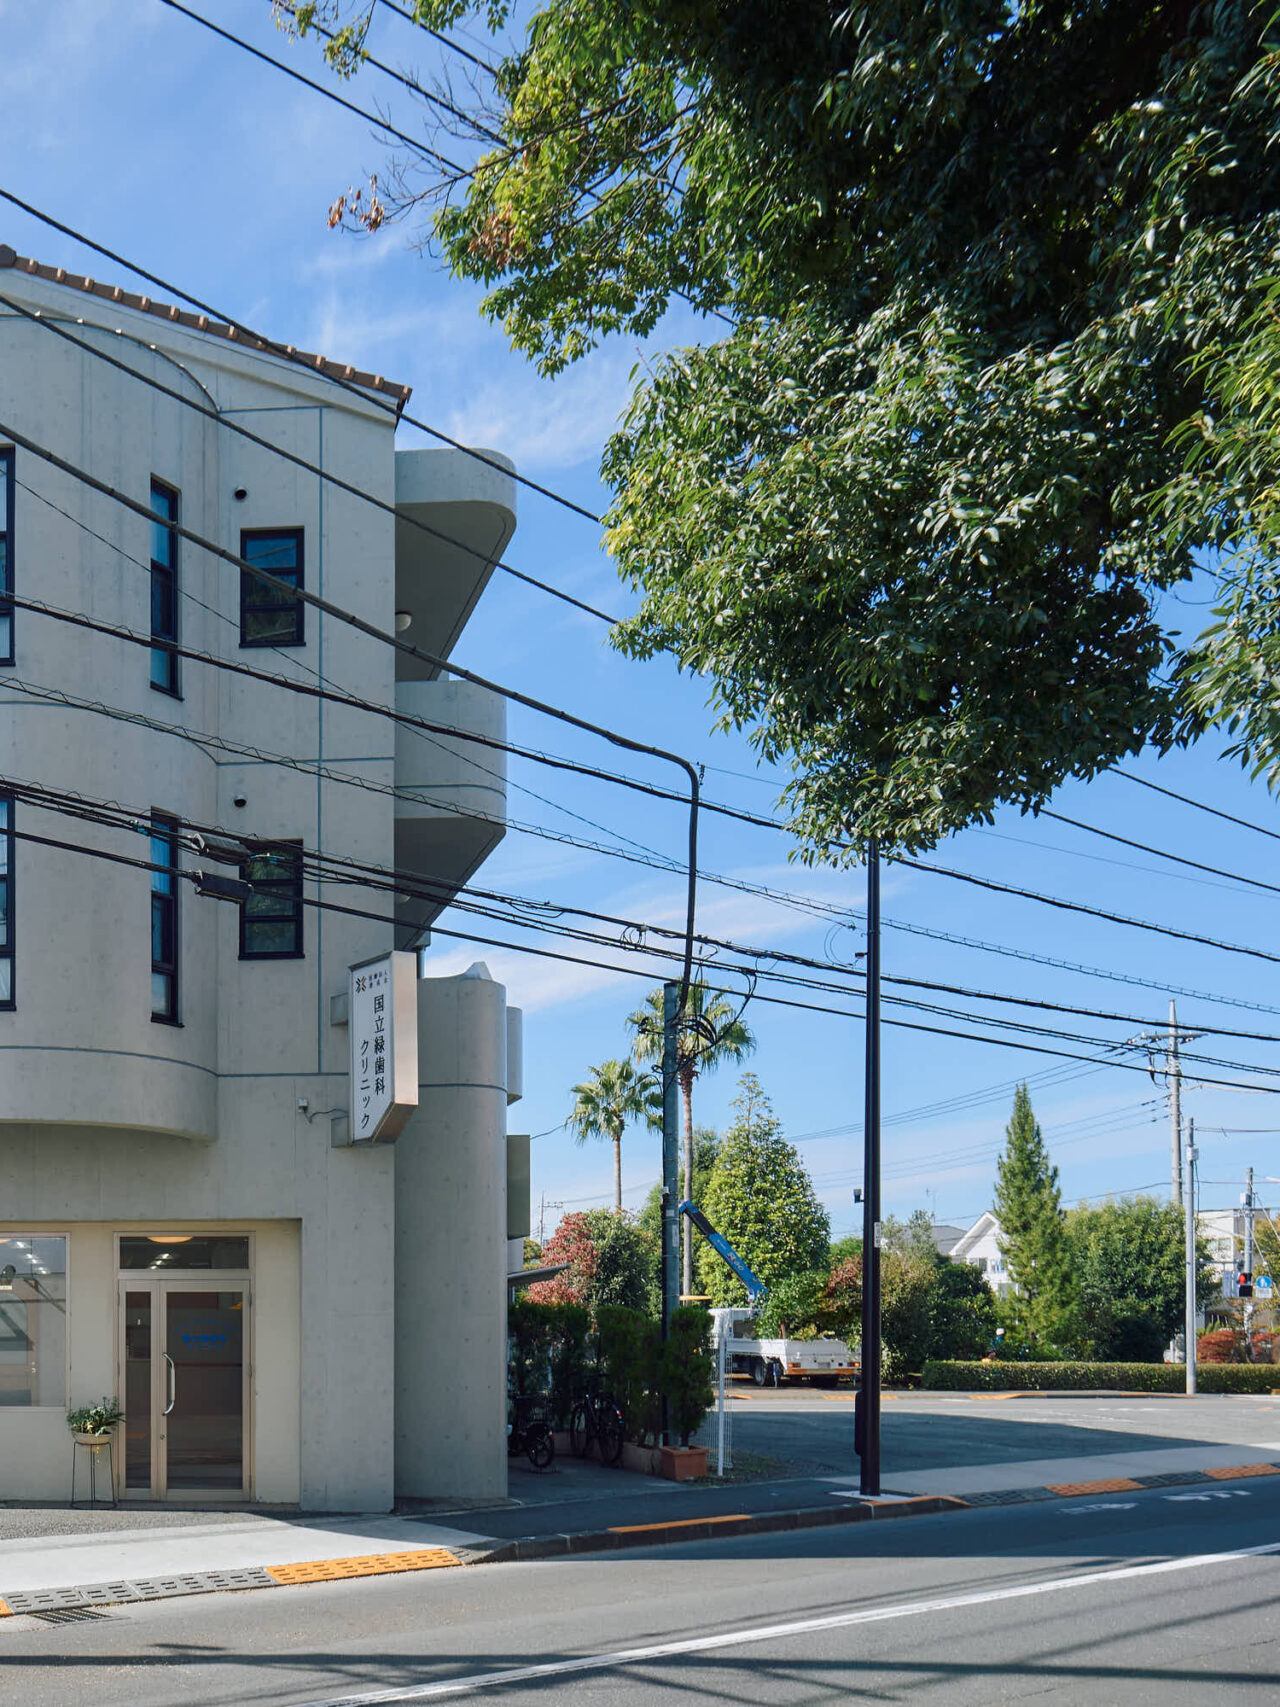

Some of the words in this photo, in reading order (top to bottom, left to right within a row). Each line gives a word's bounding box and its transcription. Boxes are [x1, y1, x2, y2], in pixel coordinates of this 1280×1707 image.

[360, 1039, 370, 1130] クリニック
[374, 993, 385, 1096] 国立緑歯科
